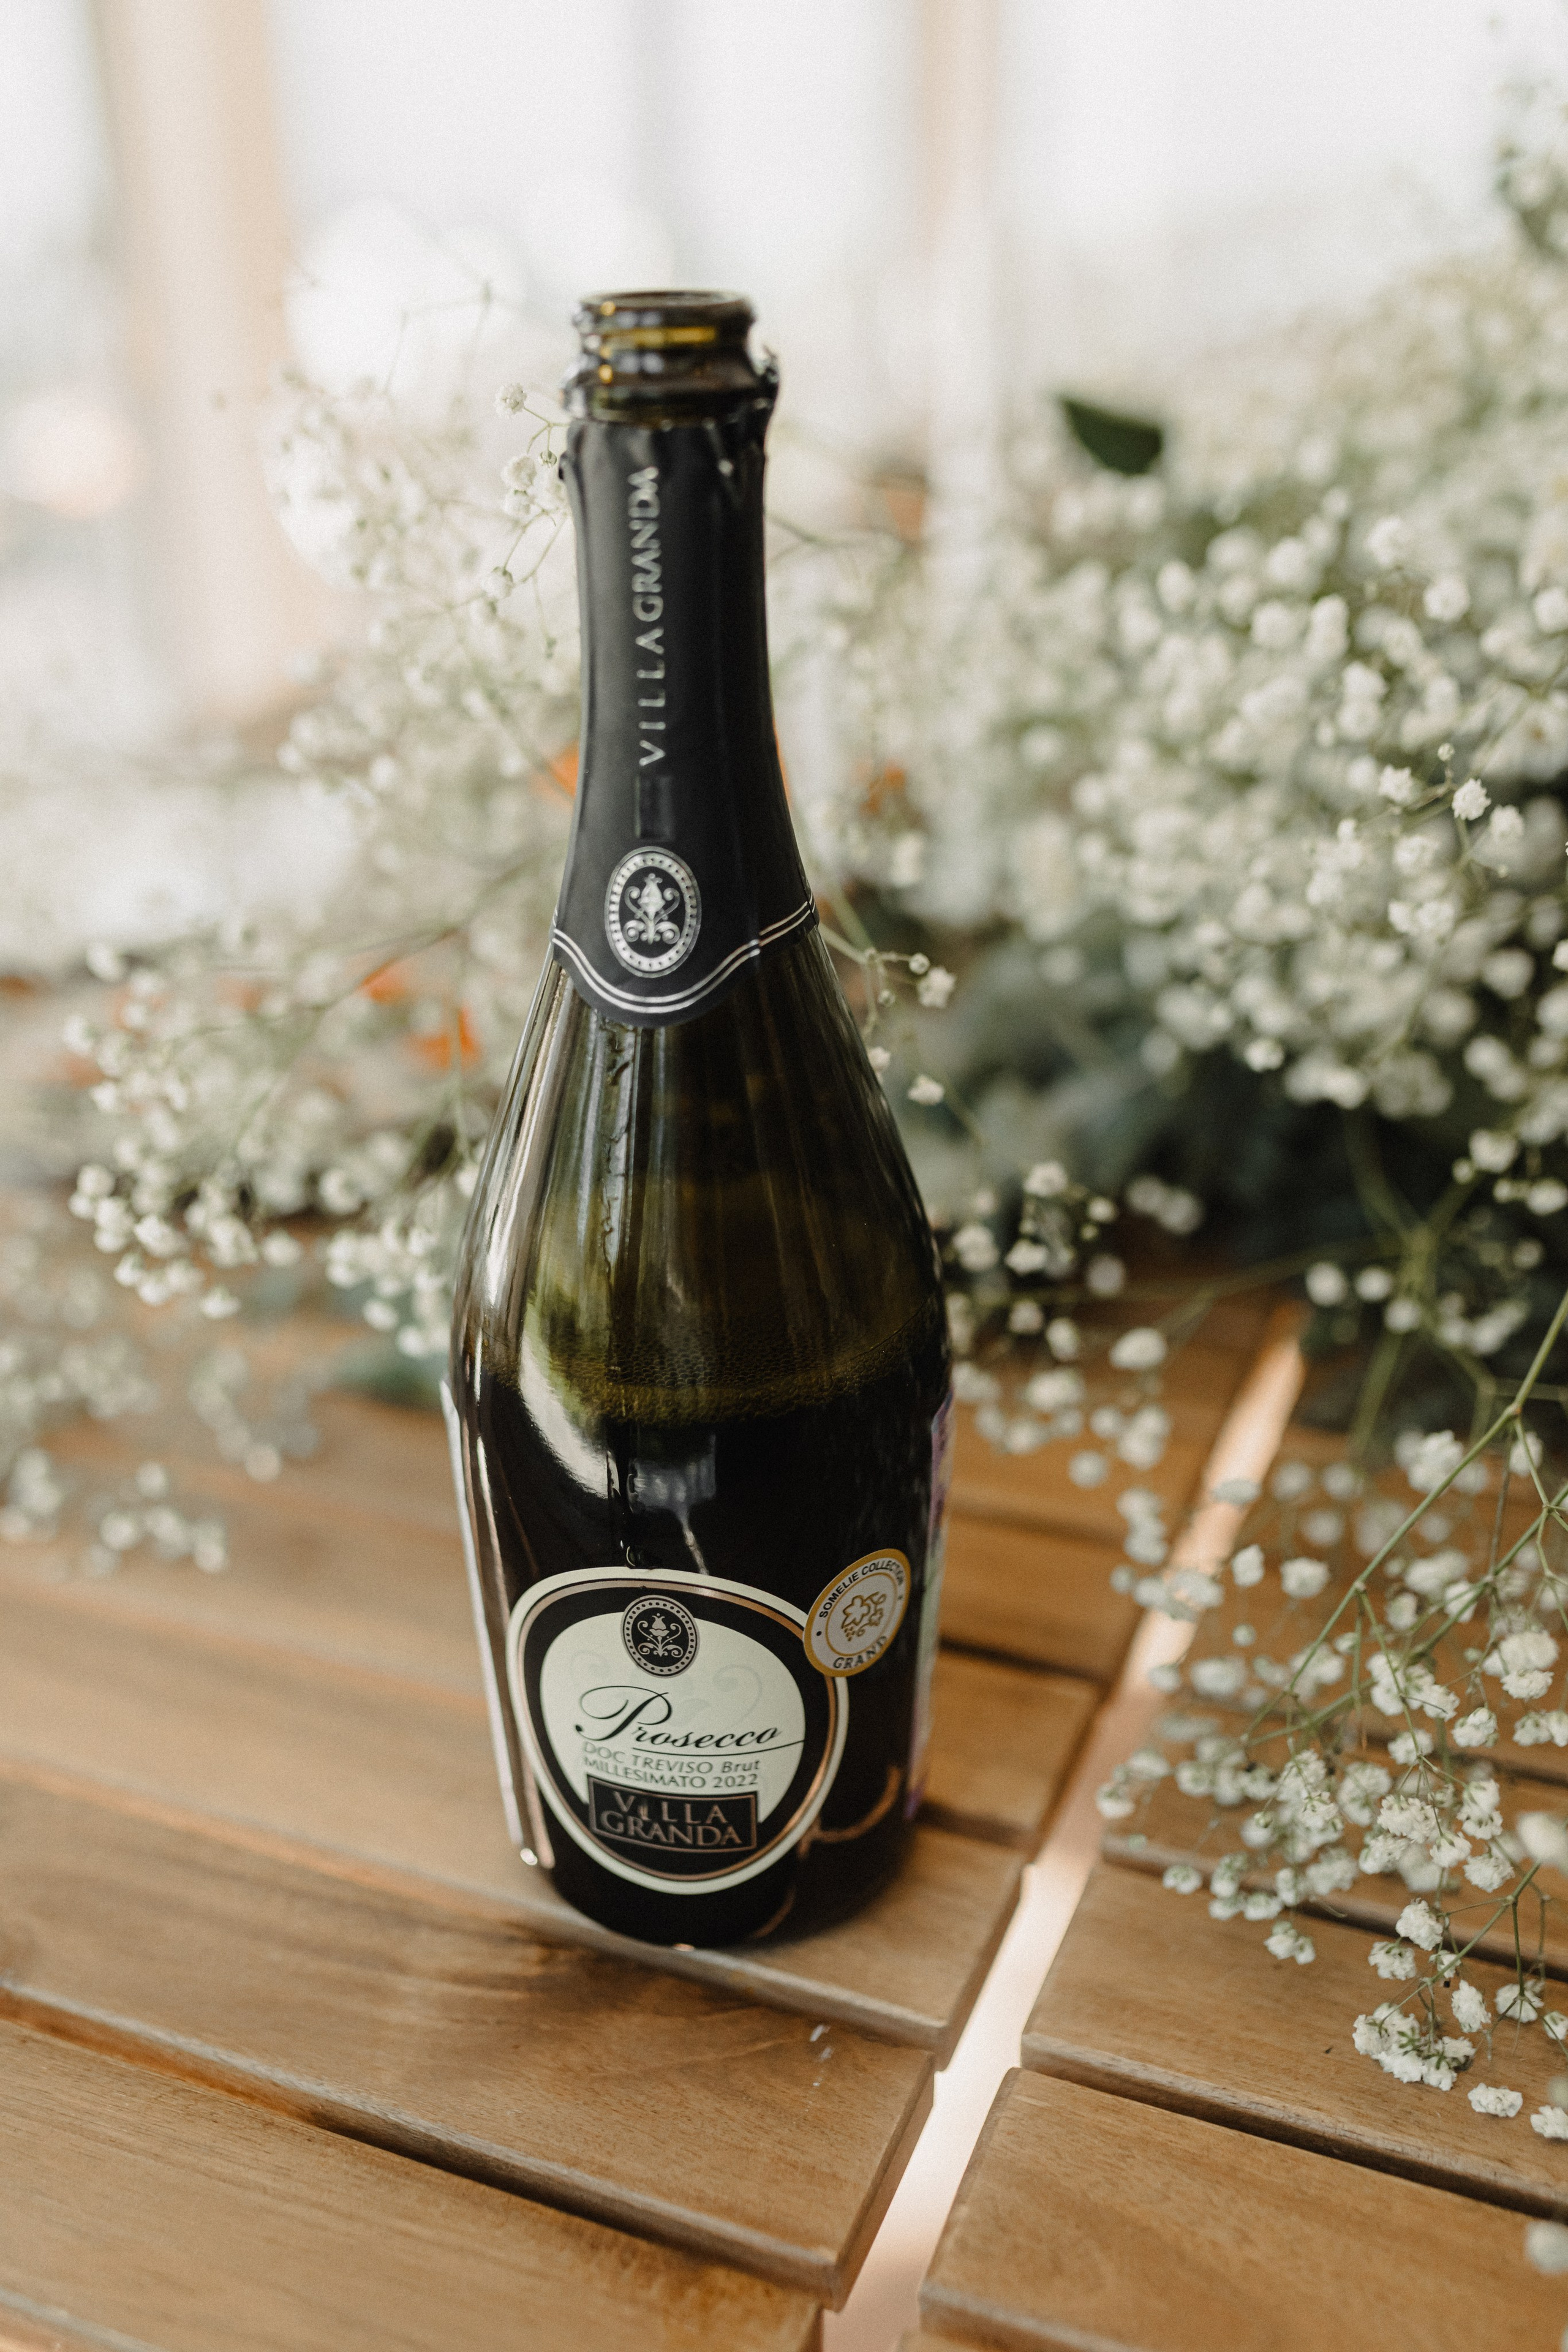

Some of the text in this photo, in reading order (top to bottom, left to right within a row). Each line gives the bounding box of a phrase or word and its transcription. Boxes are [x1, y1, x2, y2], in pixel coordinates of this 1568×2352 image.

[627, 466, 666, 767] VILLA GRANDA
[819, 1572, 860, 1618] SOMELIE
[575, 1685, 782, 1749] Prosecco
[583, 1741, 760, 1774] DOC TREVISO Brut
[583, 1754, 759, 1789] MILLESIMATO 2022
[614, 1790, 728, 1825] VILLA
[600, 1810, 742, 1846] GRANDA
